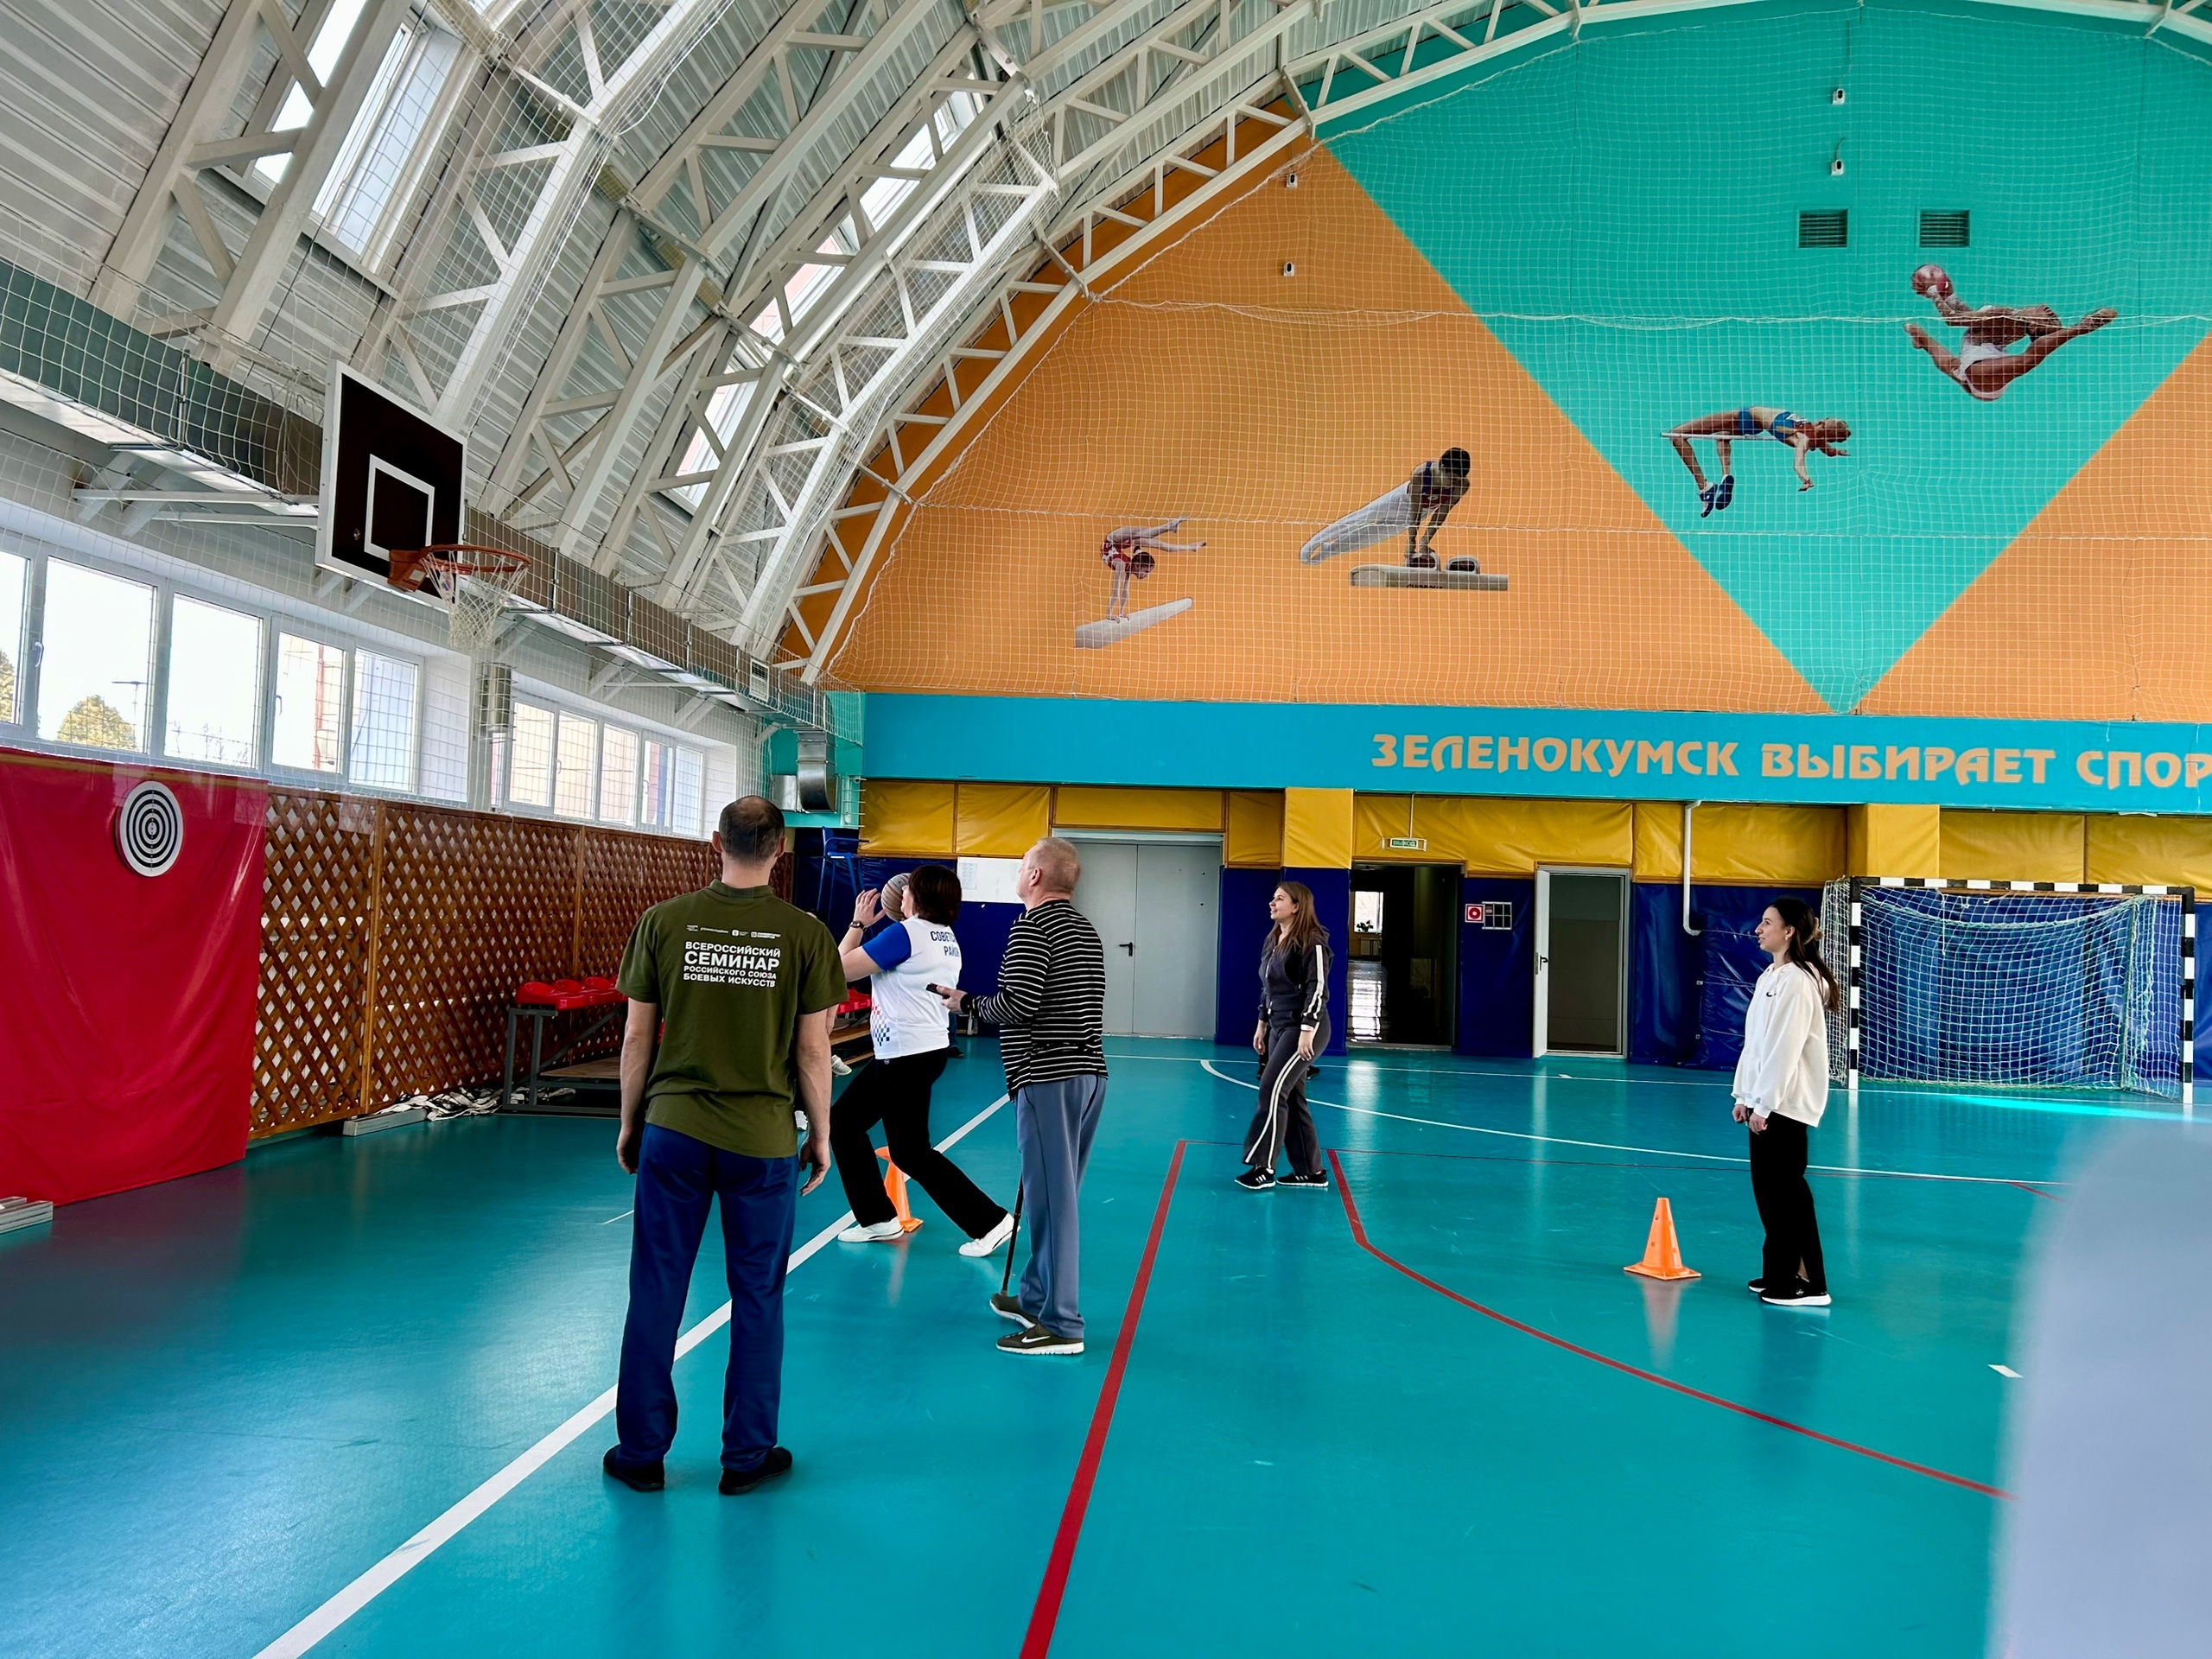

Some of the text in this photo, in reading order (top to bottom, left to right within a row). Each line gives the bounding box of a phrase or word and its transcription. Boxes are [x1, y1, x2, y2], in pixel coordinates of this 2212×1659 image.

[1371, 734, 2212, 789] ЗЕЛЕНОКУМСК ВЫБИРАЕТ СПОР
[685, 941, 781, 957] ВСЕРОССИЙСКИЙ
[684, 950, 779, 971] СЕМИНАР
[683, 965, 777, 979] РОССИЙСКОГО СОЮЗА
[683, 973, 776, 988] БОЕВЫХ ИСКУССТВ
